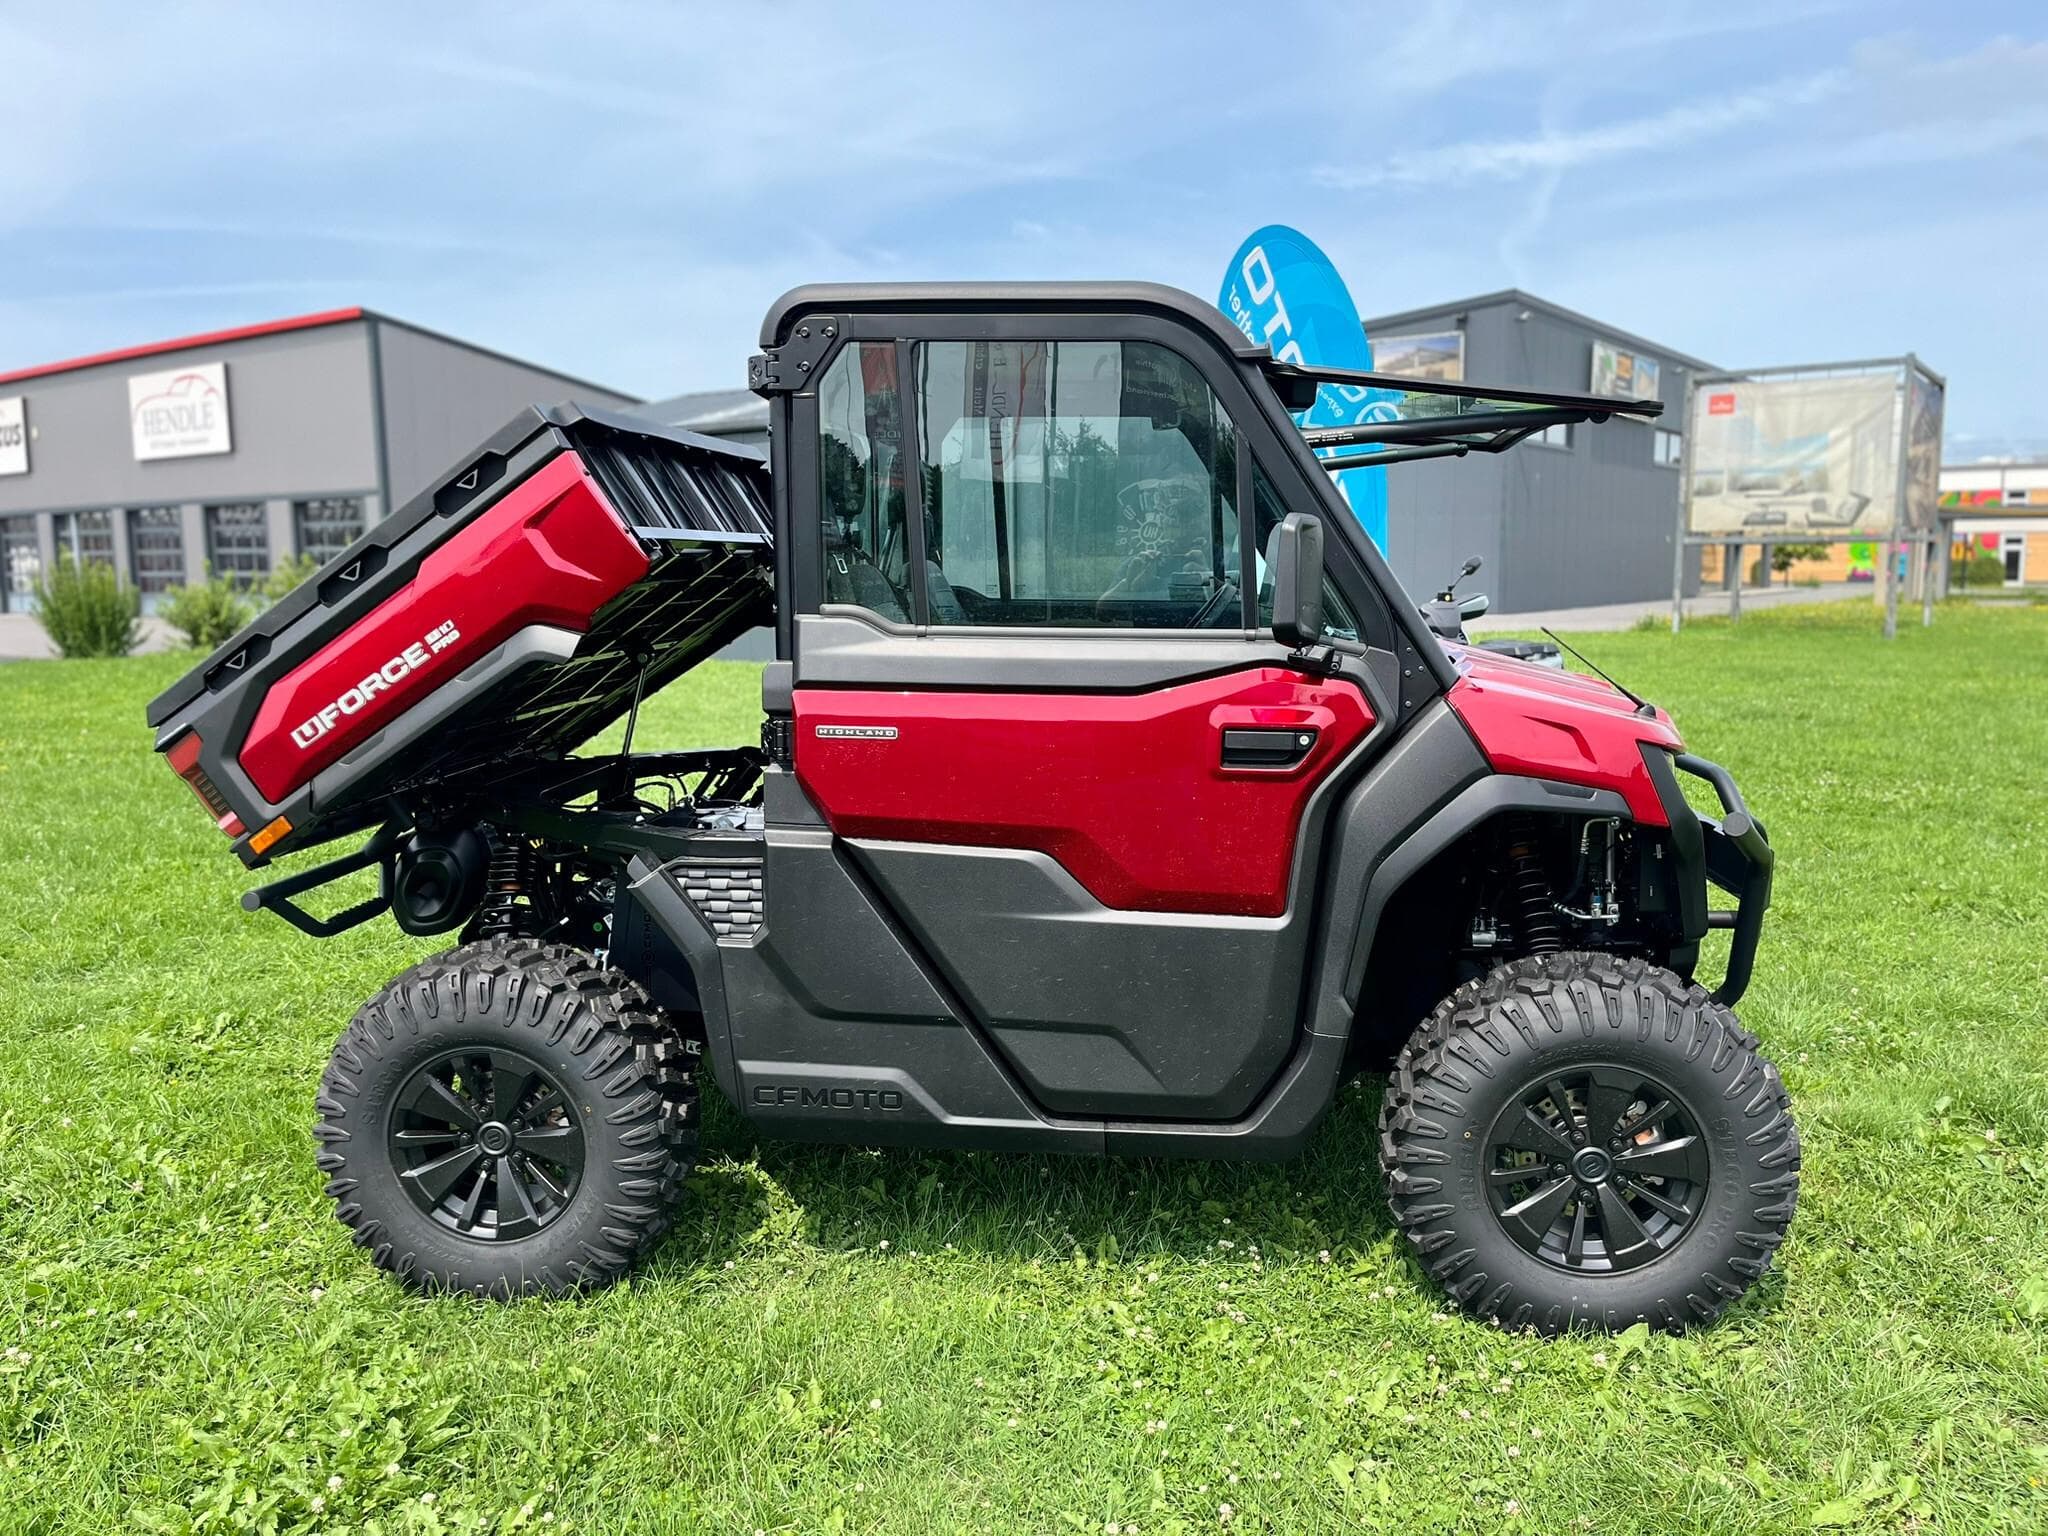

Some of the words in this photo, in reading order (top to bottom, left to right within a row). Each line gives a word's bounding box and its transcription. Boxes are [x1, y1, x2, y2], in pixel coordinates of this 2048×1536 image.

[142, 402, 217, 438] HENDLE
[290, 641, 431, 749] UFORCE
[430, 629, 461, 655] PRO
[819, 728, 894, 737] HIGHLAND
[753, 1085, 903, 1112] CFMOTO
